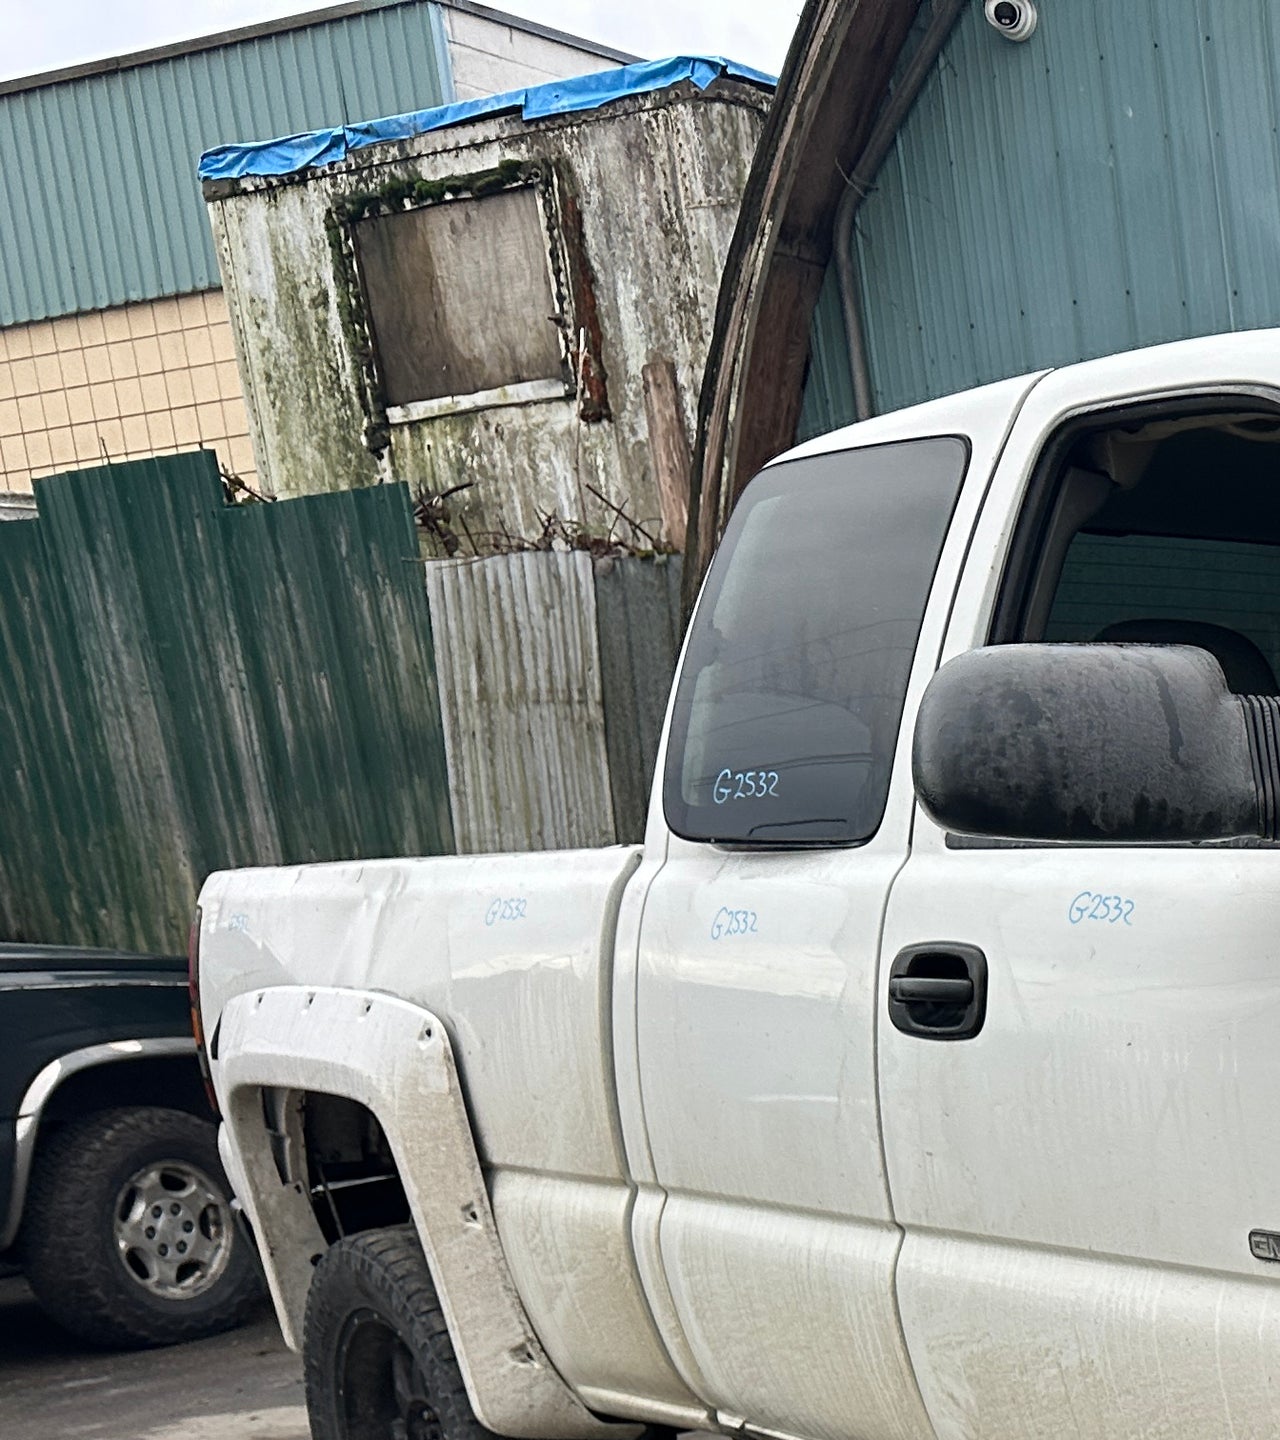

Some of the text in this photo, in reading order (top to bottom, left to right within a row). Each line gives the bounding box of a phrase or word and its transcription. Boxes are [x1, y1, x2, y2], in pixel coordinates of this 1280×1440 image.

[713, 768, 780, 804] G2532
[711, 906, 758, 940] G2532
[1068, 891, 1134, 926] G2532
